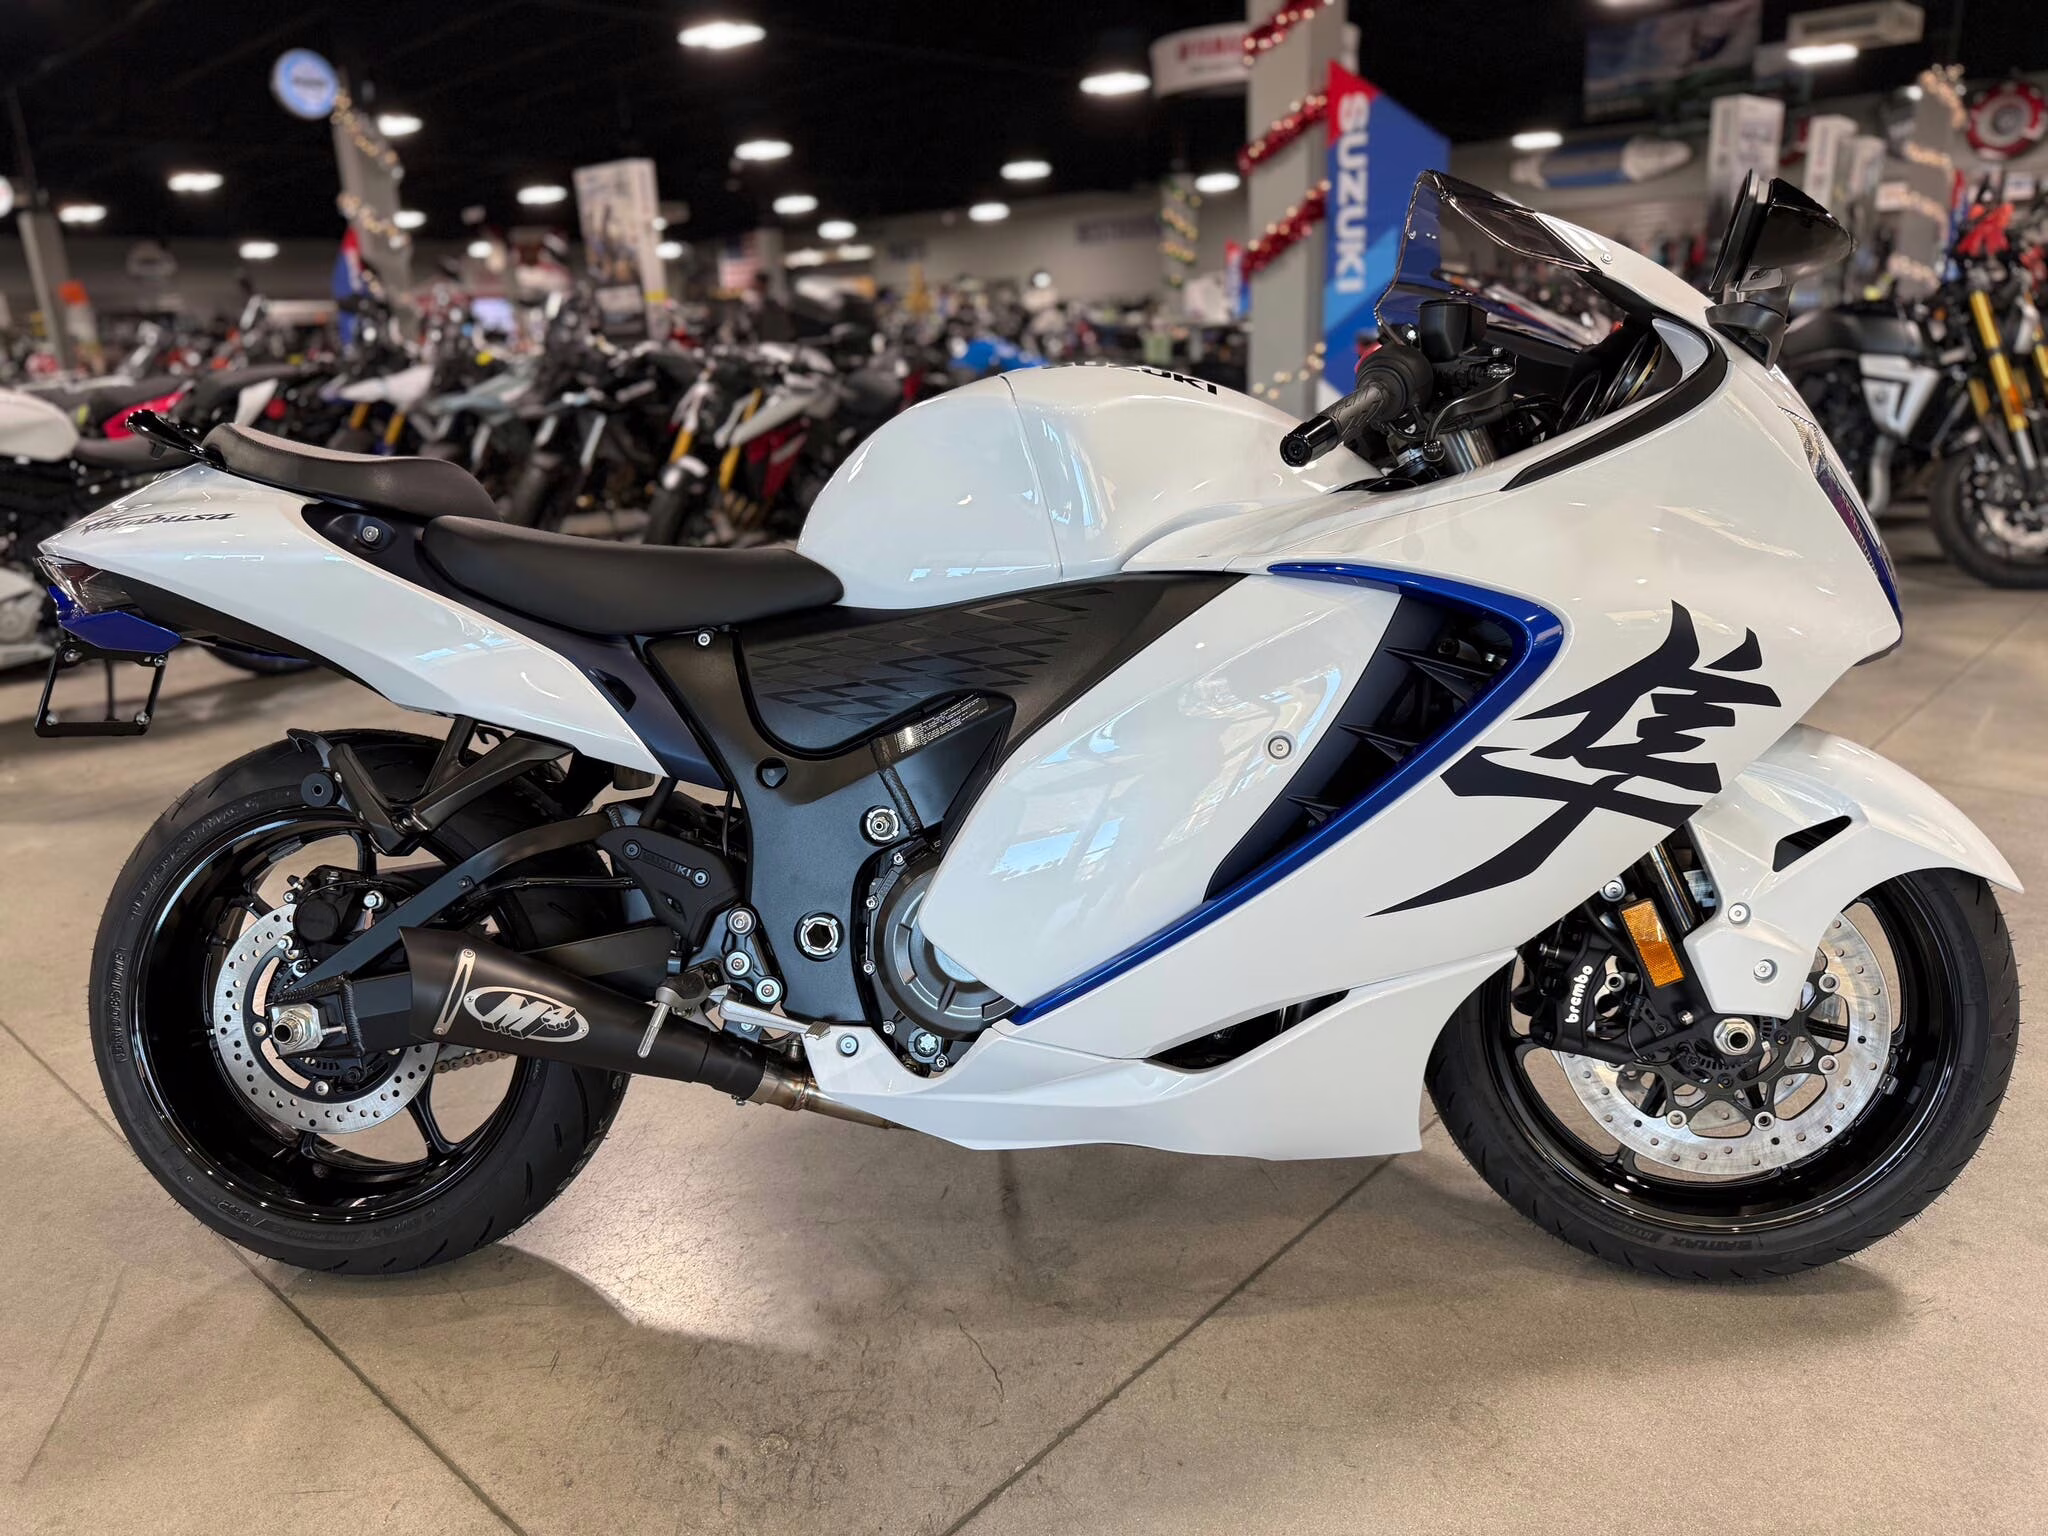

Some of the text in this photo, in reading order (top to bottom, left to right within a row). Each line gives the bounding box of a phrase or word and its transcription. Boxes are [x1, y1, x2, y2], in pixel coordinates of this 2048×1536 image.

[1336, 92, 1370, 292] SUZUKI
[480, 993, 576, 1039] M4
[1564, 965, 1593, 1023] brembo
